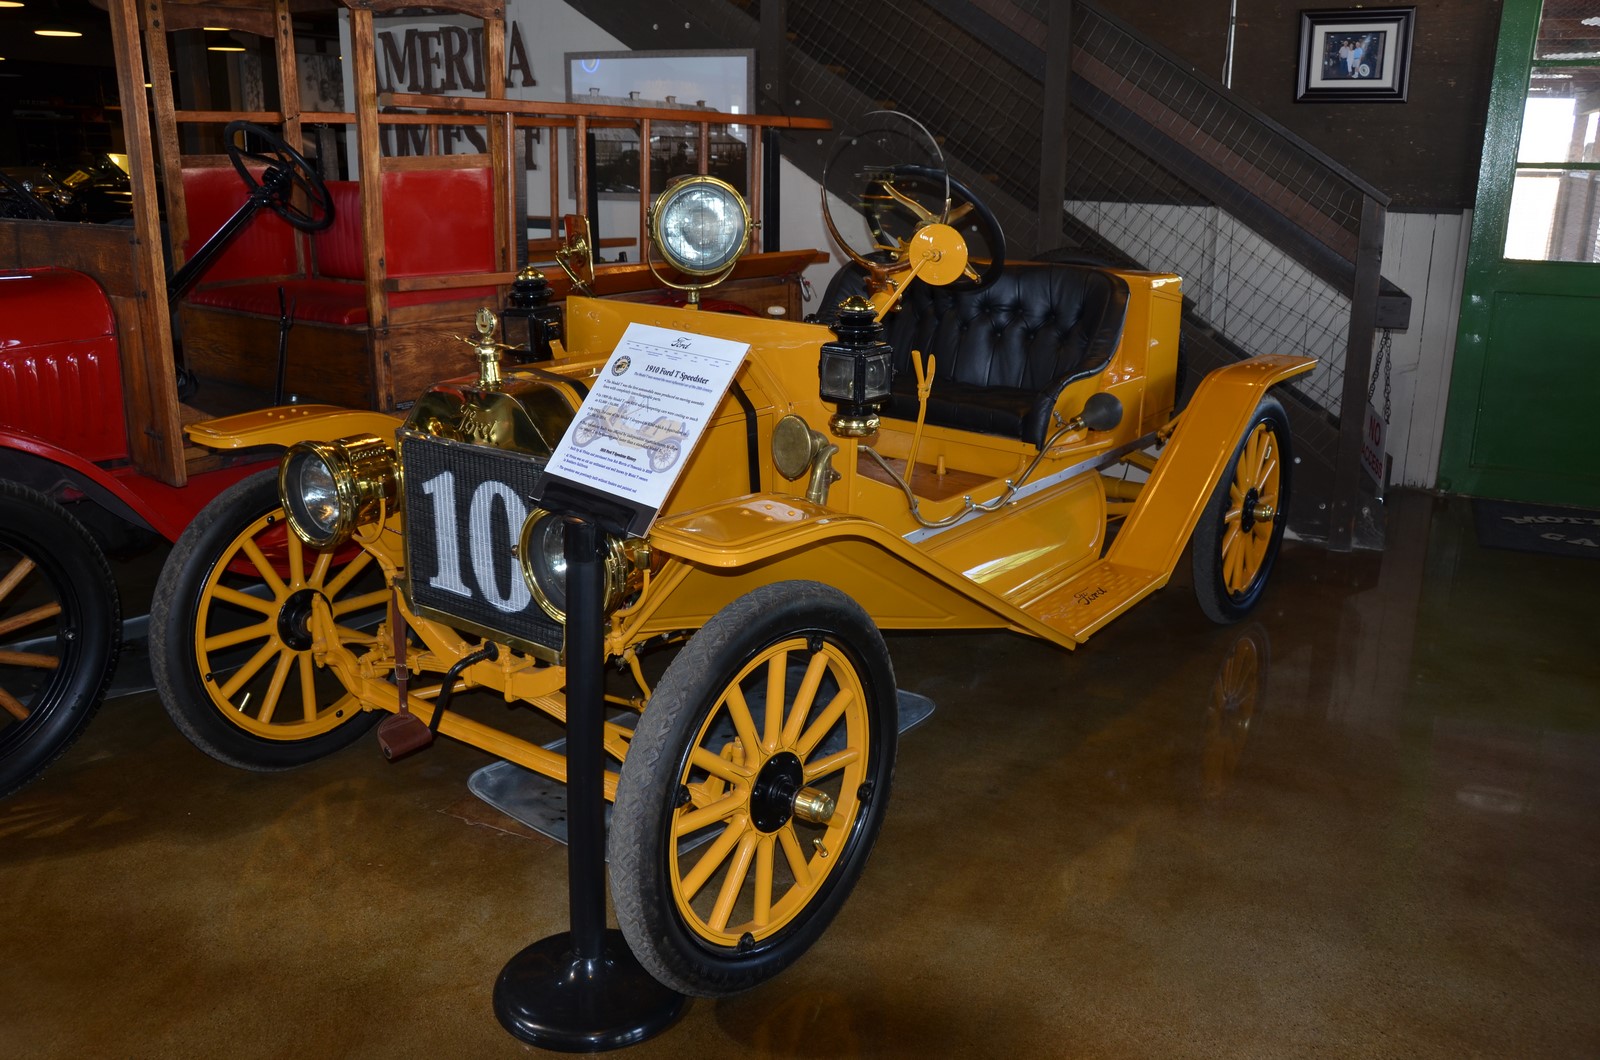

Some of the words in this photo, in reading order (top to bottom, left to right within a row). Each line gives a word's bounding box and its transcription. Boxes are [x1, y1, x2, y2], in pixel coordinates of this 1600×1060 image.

[671, 336, 692, 350] Ford
[645, 364, 661, 374] 1910
[659, 368, 675, 377] Ford
[679, 372, 710, 386] Speedster
[457, 403, 499, 444] Ford
[1368, 415, 1381, 446] NO
[1361, 443, 1382, 479] ACCESS
[422, 470, 532, 613] 10
[1074, 586, 1107, 606] Ford
